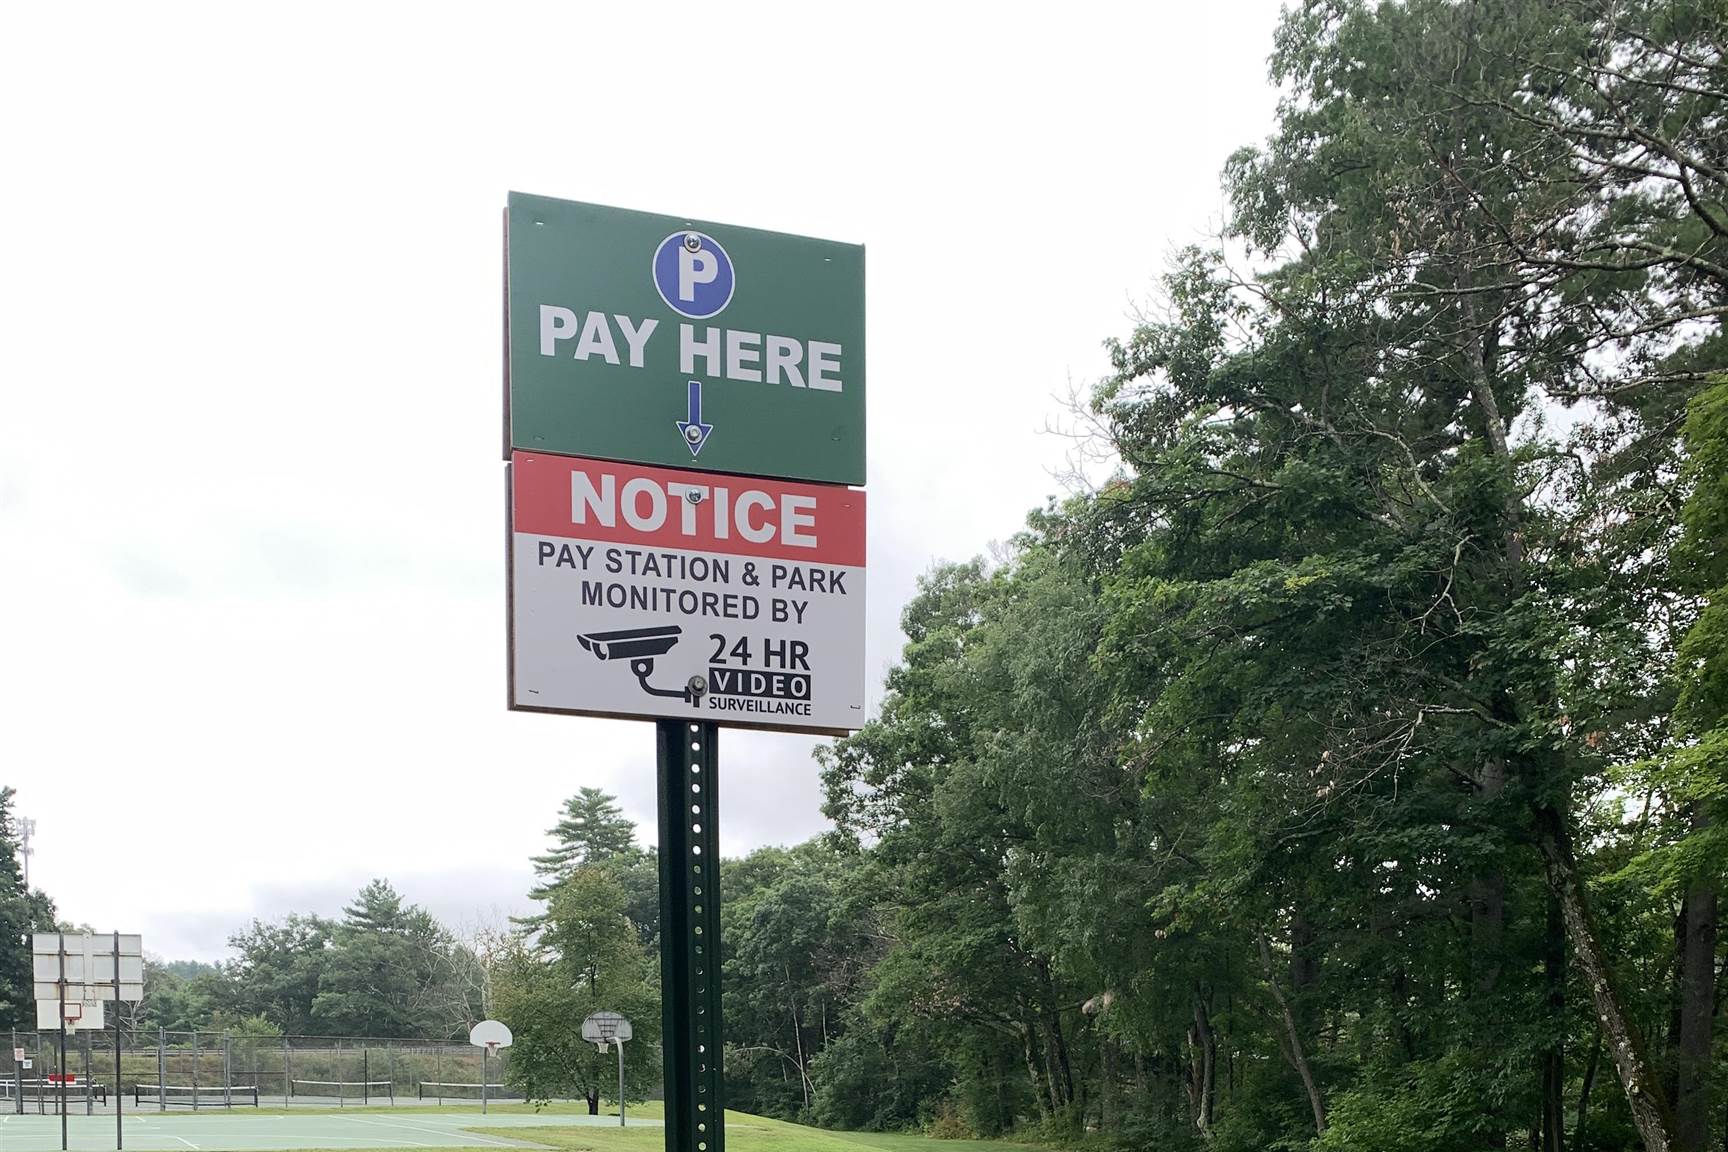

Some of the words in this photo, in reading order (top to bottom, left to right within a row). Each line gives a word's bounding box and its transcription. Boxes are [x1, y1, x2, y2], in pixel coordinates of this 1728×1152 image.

[678, 245, 719, 302] P
[539, 303, 660, 368] PAY
[679, 322, 843, 393] HERE
[570, 469, 818, 549] NOTICE
[538, 540, 595, 571] PAY
[605, 547, 730, 584] STATION
[741, 561, 760, 588] &
[771, 564, 847, 596] PARK
[581, 580, 760, 621] MONITORED
[771, 598, 809, 625] BY
[708, 633, 752, 667] 24
[764, 638, 811, 671] HR
[708, 696, 812, 717] SURVEILLANCE
[713, 670, 808, 698] VIDEO
